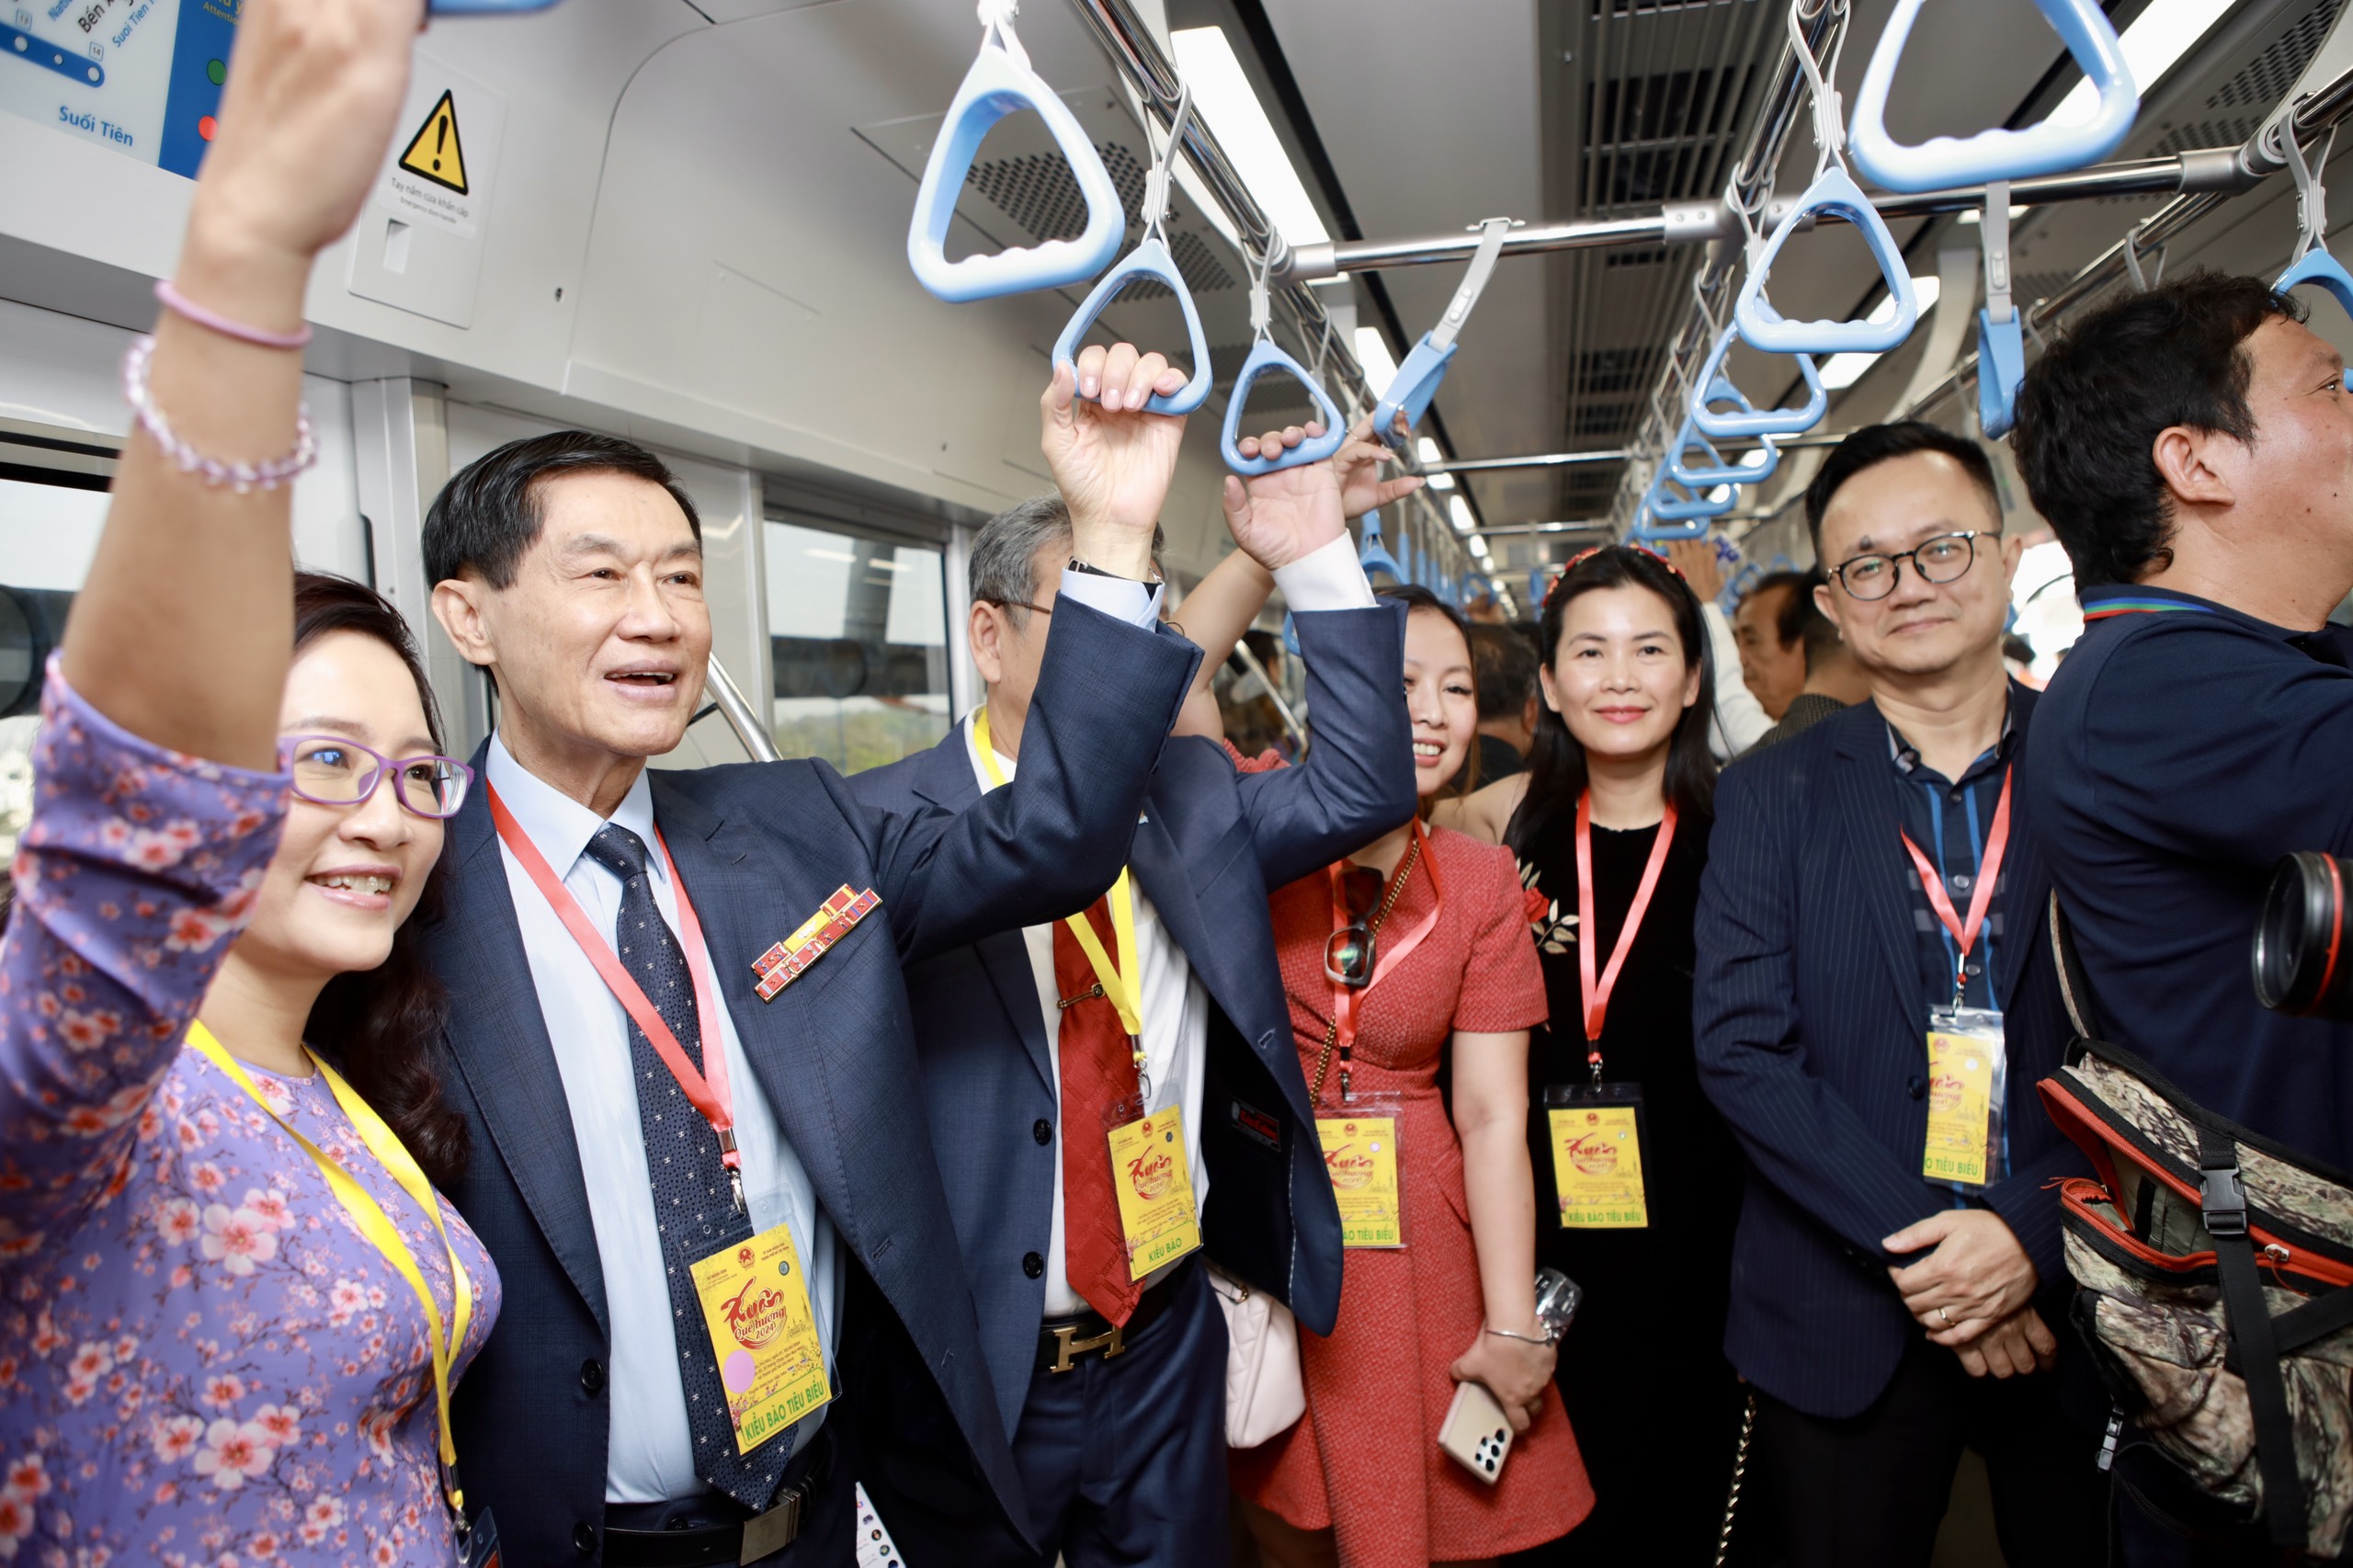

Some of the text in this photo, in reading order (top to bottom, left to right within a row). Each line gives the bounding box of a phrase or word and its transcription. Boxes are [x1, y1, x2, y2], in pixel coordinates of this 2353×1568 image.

[77, 5, 106, 33] Bến
[112, 22, 132, 48] Suoi
[129, 4, 150, 25] Tien
[92, 47, 101, 56] 14
[59, 106, 133, 146] Suối Tiên
[1936, 1156, 1955, 1173] TIÊU
[1343, 1227, 1355, 1240] ÀO
[1357, 1227, 1374, 1240] TIÊU
[1148, 1238, 1182, 1262] KIỀU BÀO
[721, 1276, 785, 1324] Xuân
[734, 1307, 787, 1341] Quê hương
[755, 1323, 774, 1339] 2024
[745, 1375, 824, 1441] KIỀU BÀO TIÊU BIỂU
